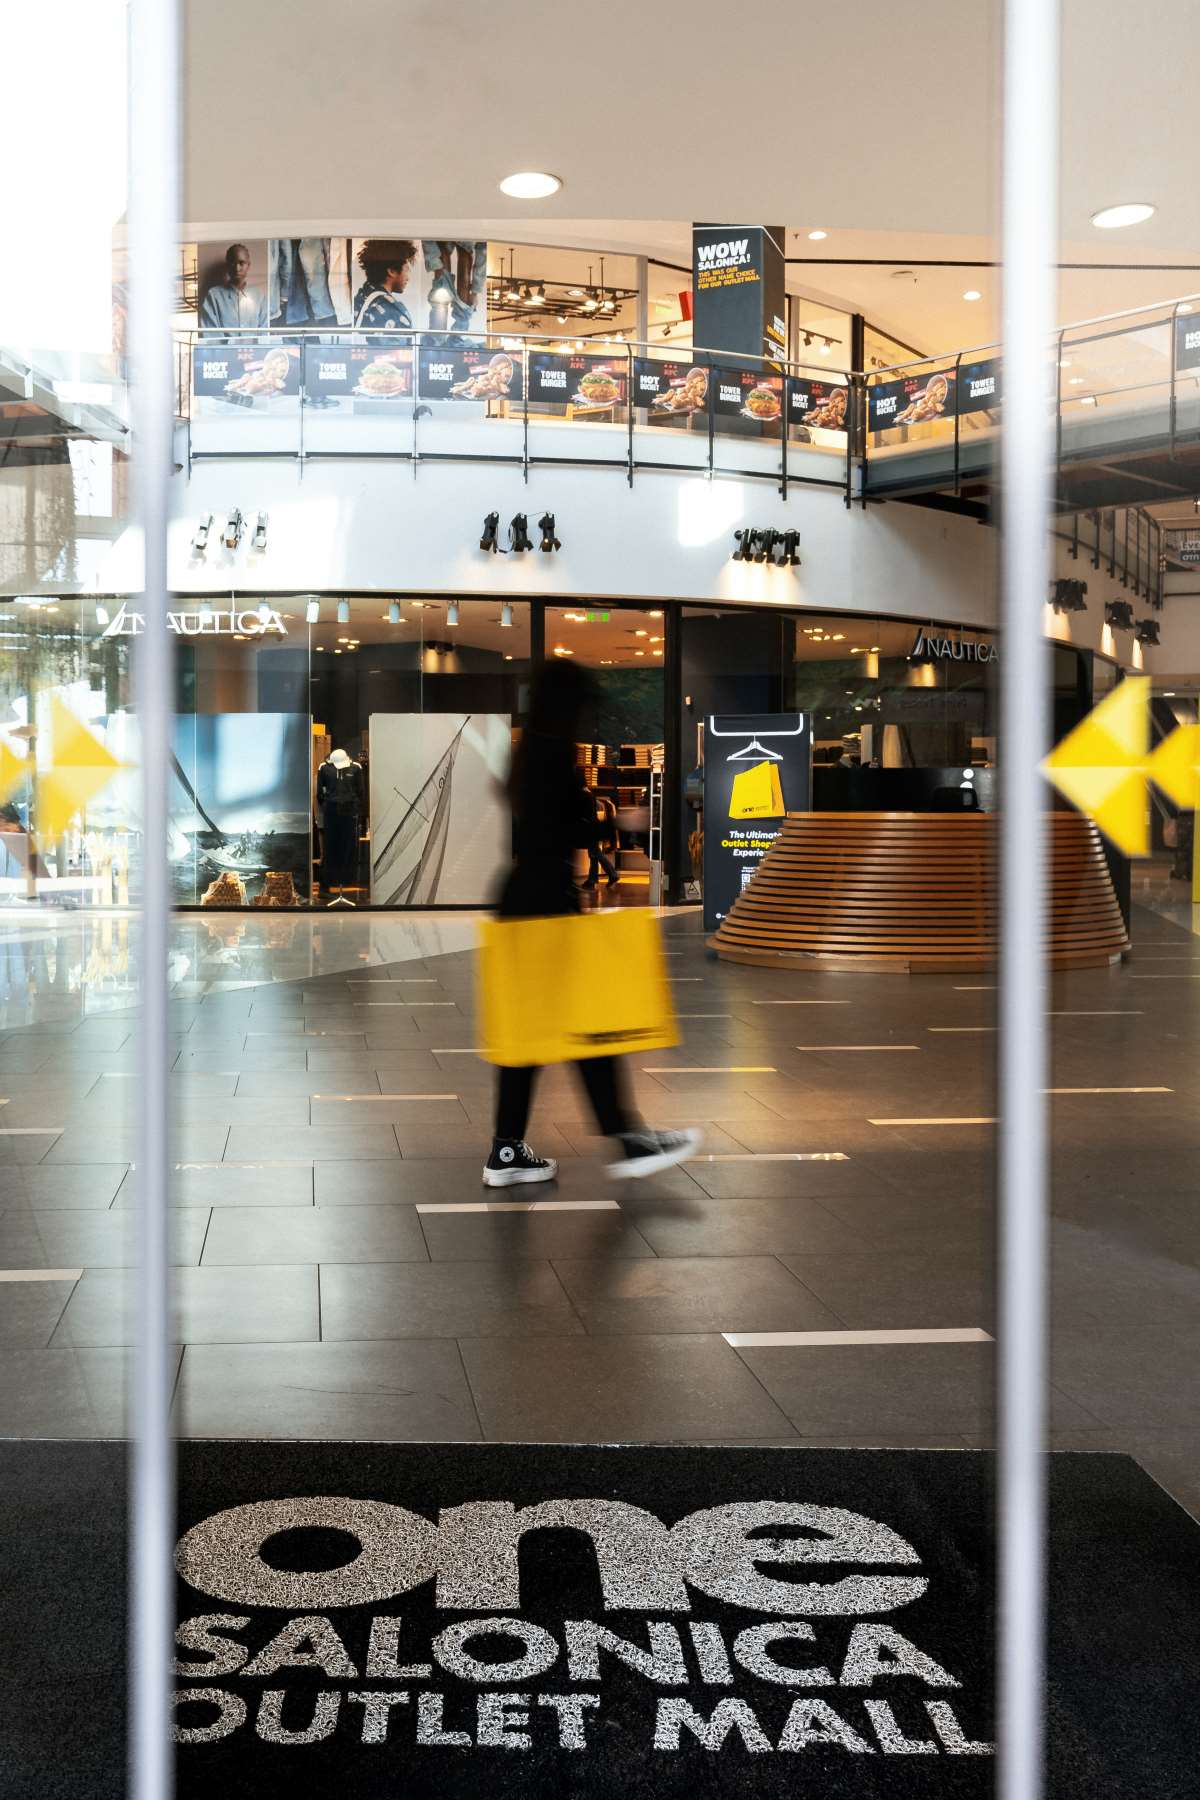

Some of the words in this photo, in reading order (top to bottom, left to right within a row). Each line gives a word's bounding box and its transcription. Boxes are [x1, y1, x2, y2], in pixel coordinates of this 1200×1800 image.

[697, 239, 749, 262] WOW
[698, 254, 751, 271] SALONICA!
[203, 362, 228, 372] HOT
[319, 363, 347, 372] TOWER
[429, 363, 453, 374] HOT
[203, 371, 228, 379] BUCKET
[429, 372, 453, 381] BUCKET
[540, 370, 567, 380] TOWER
[640, 375, 660, 385] HOT
[541, 379, 567, 388] BURGER
[640, 383, 659, 391] BUCKET
[970, 377, 995, 391] TOWER
[720, 385, 741, 395] TOWER
[970, 387, 995, 398] BURGER
[720, 393, 742, 402] BURGER
[792, 392, 809, 402] HOT
[876, 396, 898, 408] HOT
[792, 401, 809, 409] BUCKET
[876, 405, 897, 416] BUCKET
[927, 637, 999, 663] NAUTICA
[729, 830, 745, 839] The
[721, 840, 749, 848] Outlet
[173, 1496, 930, 1615] one
[170, 1613, 963, 1688] SALONICA
[170, 1688, 602, 1752] OUTLET
[652, 1697, 999, 1756] MALL
